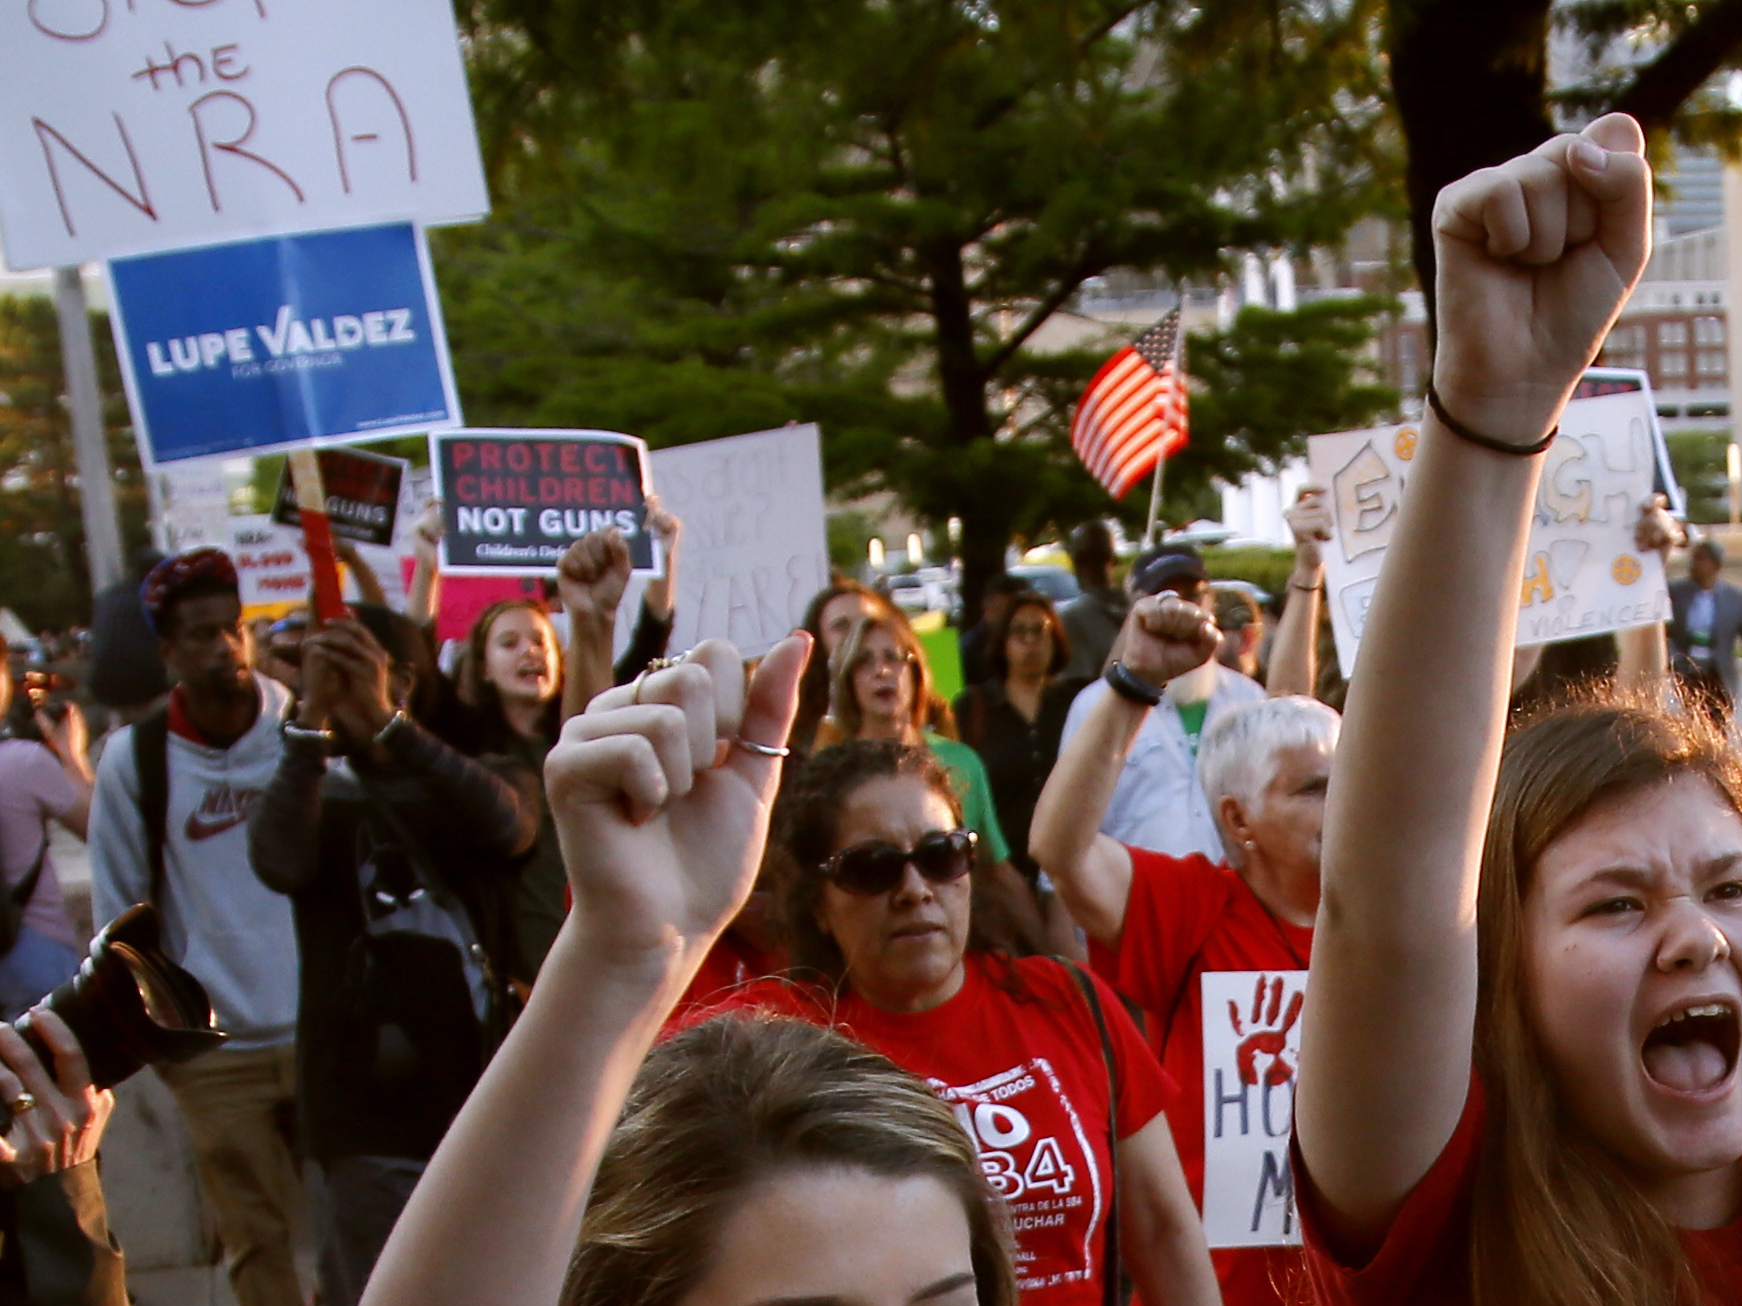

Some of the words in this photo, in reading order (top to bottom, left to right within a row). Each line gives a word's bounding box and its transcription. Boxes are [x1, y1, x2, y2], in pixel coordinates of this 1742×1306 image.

[31, 65, 418, 237] NRA
[146, 326, 255, 375] LUPE
[256, 304, 416, 358] VALDEZ
[452, 441, 631, 472] PROTECT
[454, 474, 635, 504] CHILDREN
[456, 506, 530, 536] NOT
[538, 507, 640, 538] GUNS
[991, 1074, 1037, 1101] TODOS
[1213, 1067, 1295, 1139] HO
[977, 1135, 1076, 1200] B4
[1012, 1213, 1066, 1231] UCHAR
